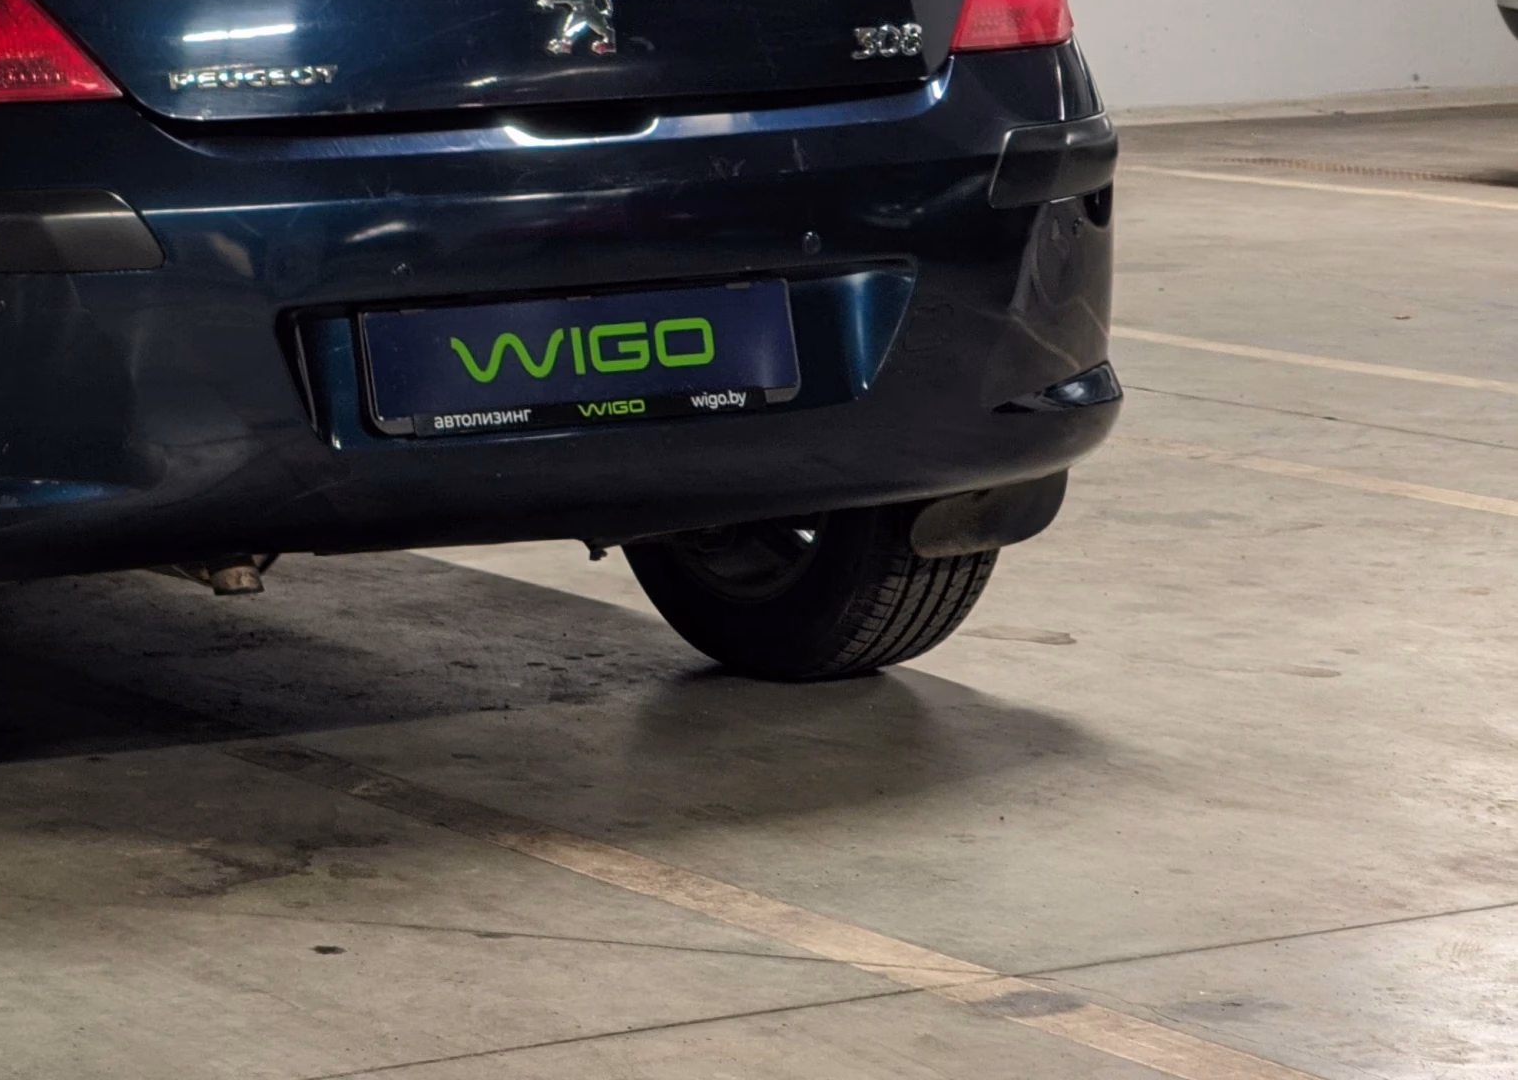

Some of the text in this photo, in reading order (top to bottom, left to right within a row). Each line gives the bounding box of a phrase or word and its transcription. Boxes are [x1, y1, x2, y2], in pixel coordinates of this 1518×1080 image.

[851, 23, 922, 60] 308
[168, 65, 338, 90] PEUGEOT
[450, 318, 715, 383] WIGO
[433, 389, 746, 429] автолизинг WIGO wigo.by
